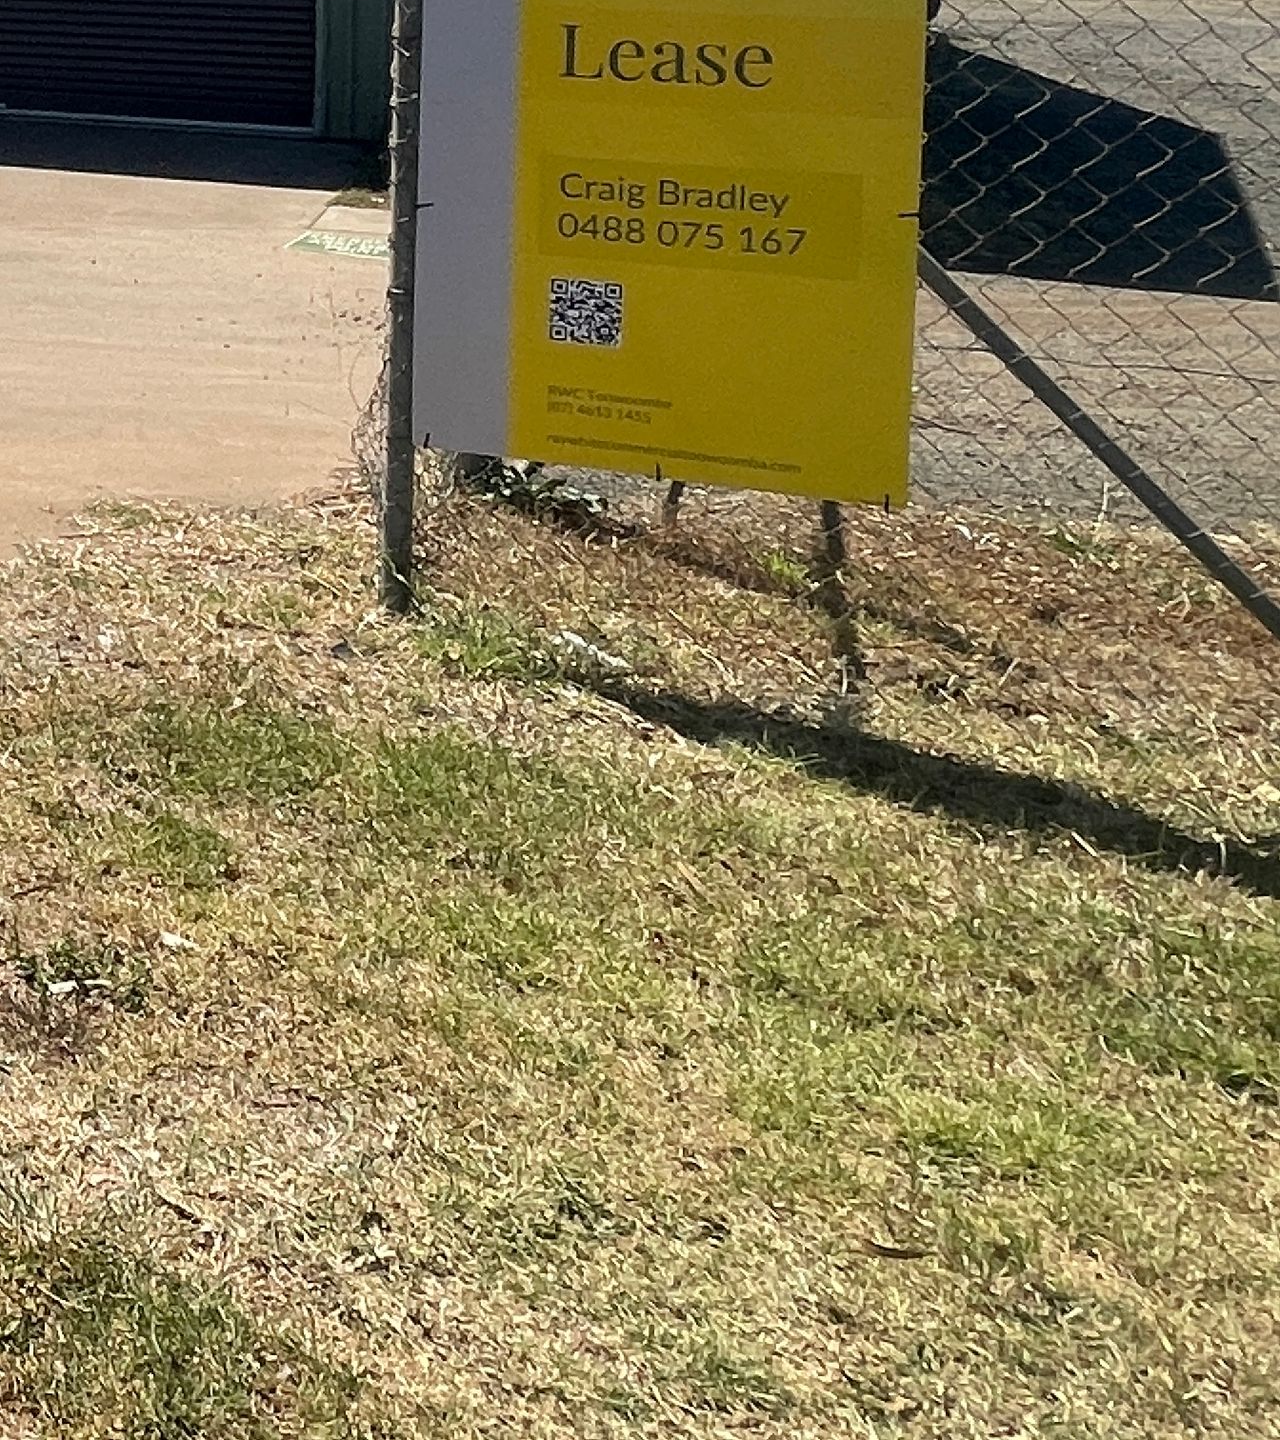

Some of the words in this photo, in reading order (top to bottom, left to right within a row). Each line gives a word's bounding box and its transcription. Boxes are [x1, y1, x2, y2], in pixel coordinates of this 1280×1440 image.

[558, 23, 774, 88] Lease
[559, 172, 646, 209] Craig
[658, 178, 790, 218] Bradley
[557, 212, 647, 245] 0488
[656, 220, 725, 249] 075
[739, 226, 808, 255] 167
[546, 384, 585, 400] RWC
